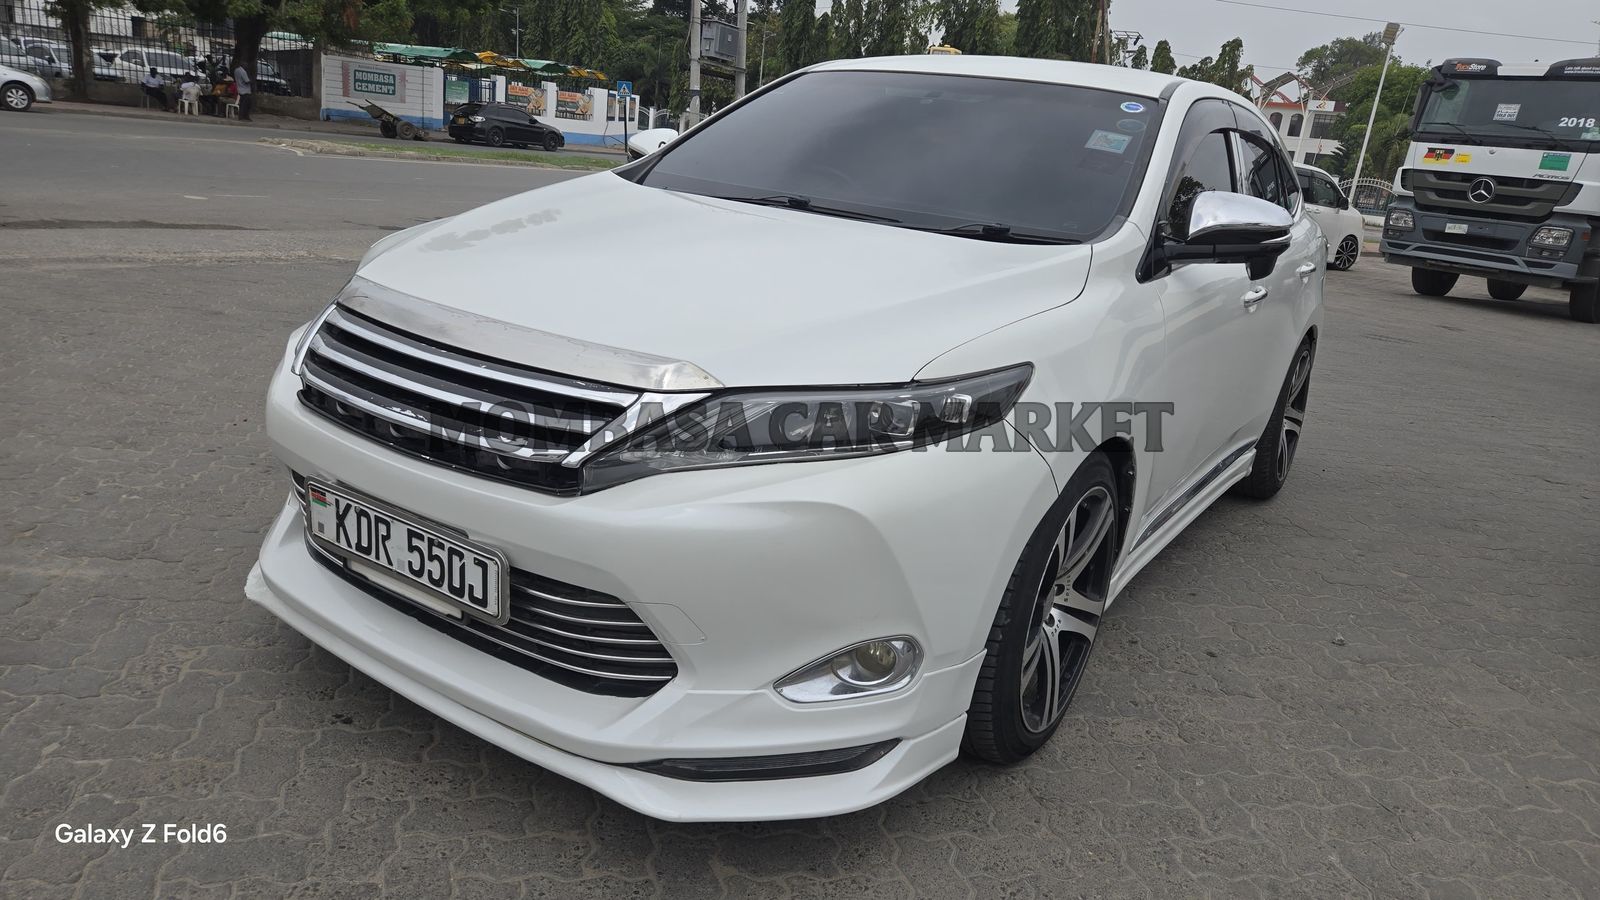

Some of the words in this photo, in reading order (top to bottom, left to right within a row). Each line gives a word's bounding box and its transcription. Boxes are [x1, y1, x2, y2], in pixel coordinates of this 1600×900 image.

[355, 71, 395, 83] MOMBASA
[355, 82, 395, 94] CEMENT
[1558, 117, 1596, 128] 2018
[335, 498, 393, 566] KDR
[406, 527, 489, 609] 550J
